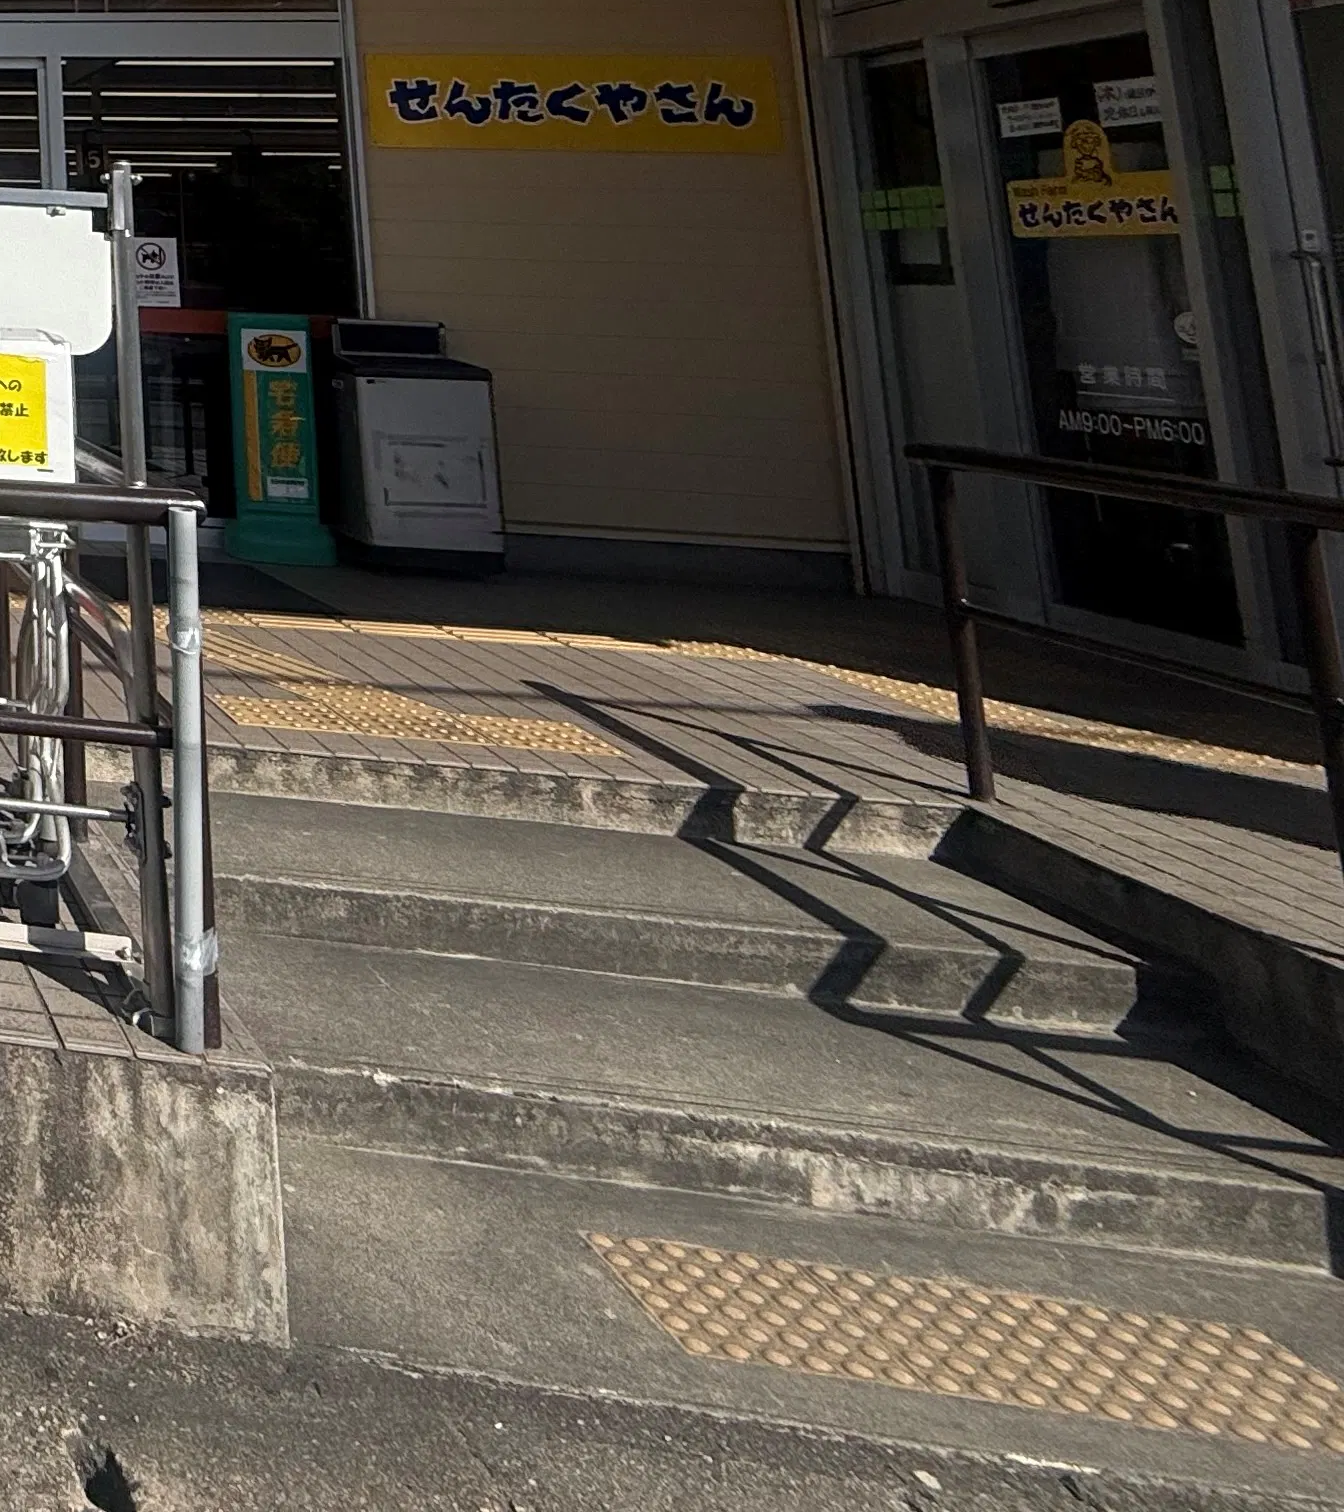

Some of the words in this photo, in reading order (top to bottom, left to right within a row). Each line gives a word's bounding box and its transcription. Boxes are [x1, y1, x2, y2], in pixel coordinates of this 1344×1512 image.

[386, 78, 756, 129] せんたくやさん
[88, 149, 101, 169] 5
[1018, 195, 1179, 228] せんたくやさん
[1077, 362, 1169, 390] 営業時間
